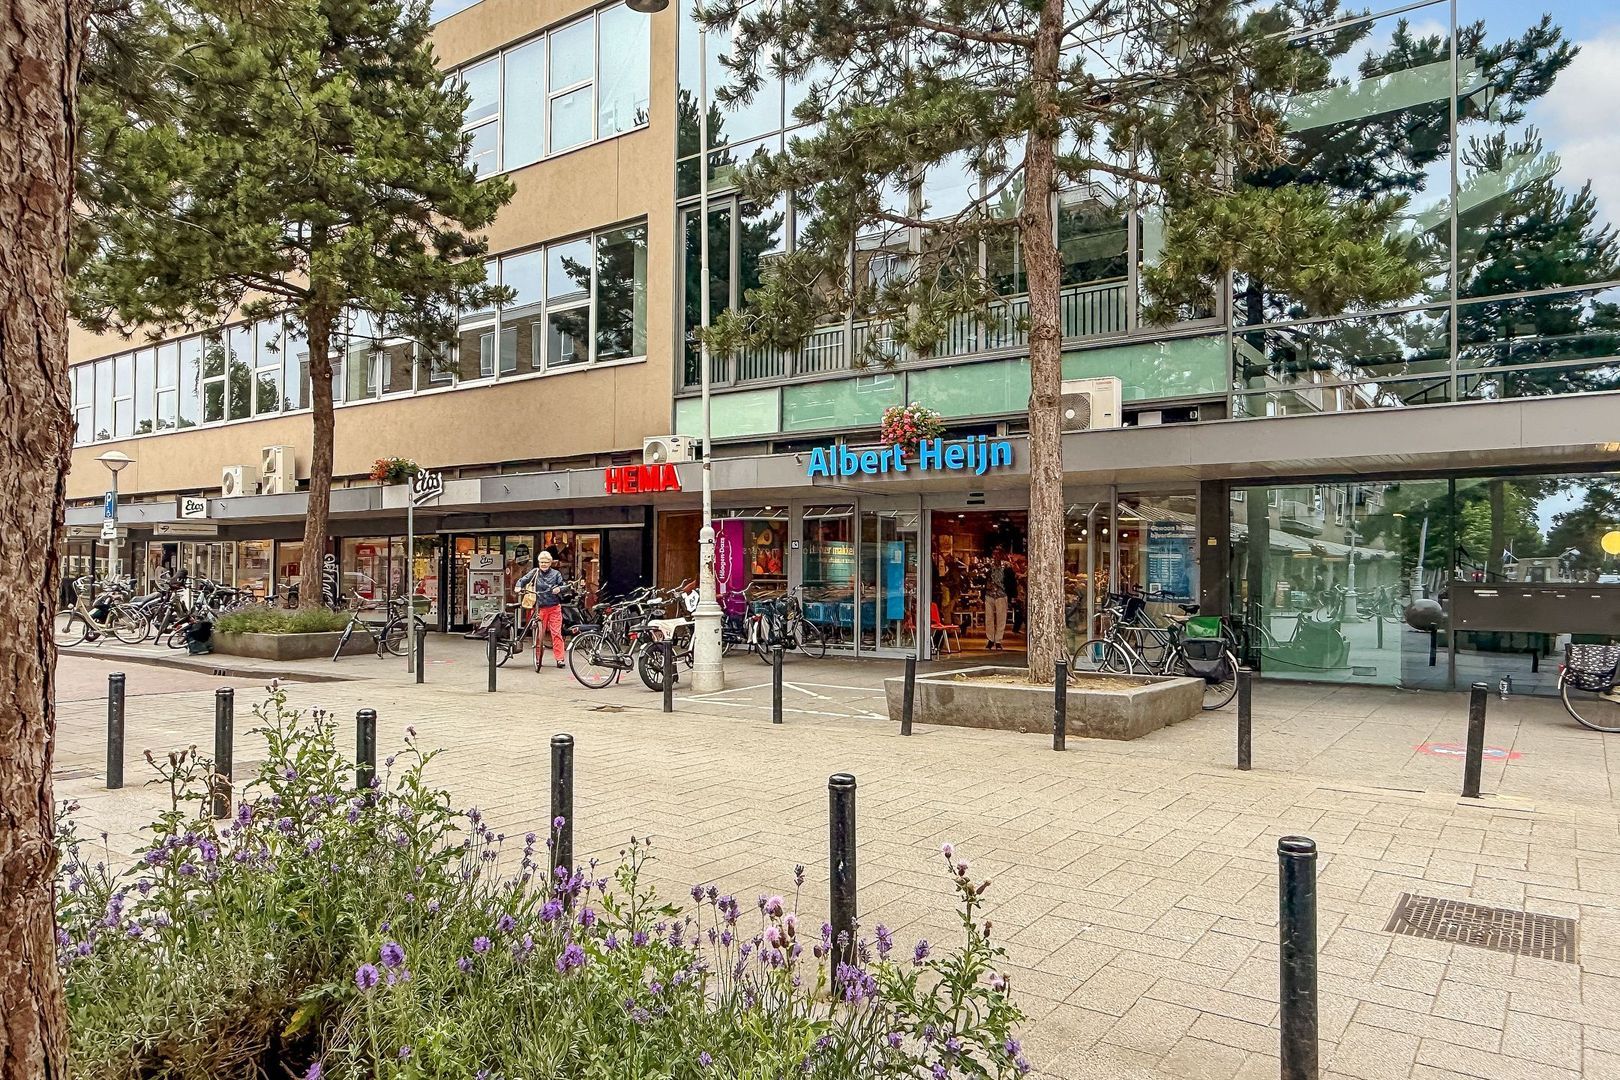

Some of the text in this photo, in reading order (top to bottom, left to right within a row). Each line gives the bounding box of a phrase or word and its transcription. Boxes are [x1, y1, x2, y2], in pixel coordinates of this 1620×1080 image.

[807, 434, 1012, 477] Albert Heijn
[604, 463, 682, 495] HEMA
[185, 499, 204, 514] Etos
